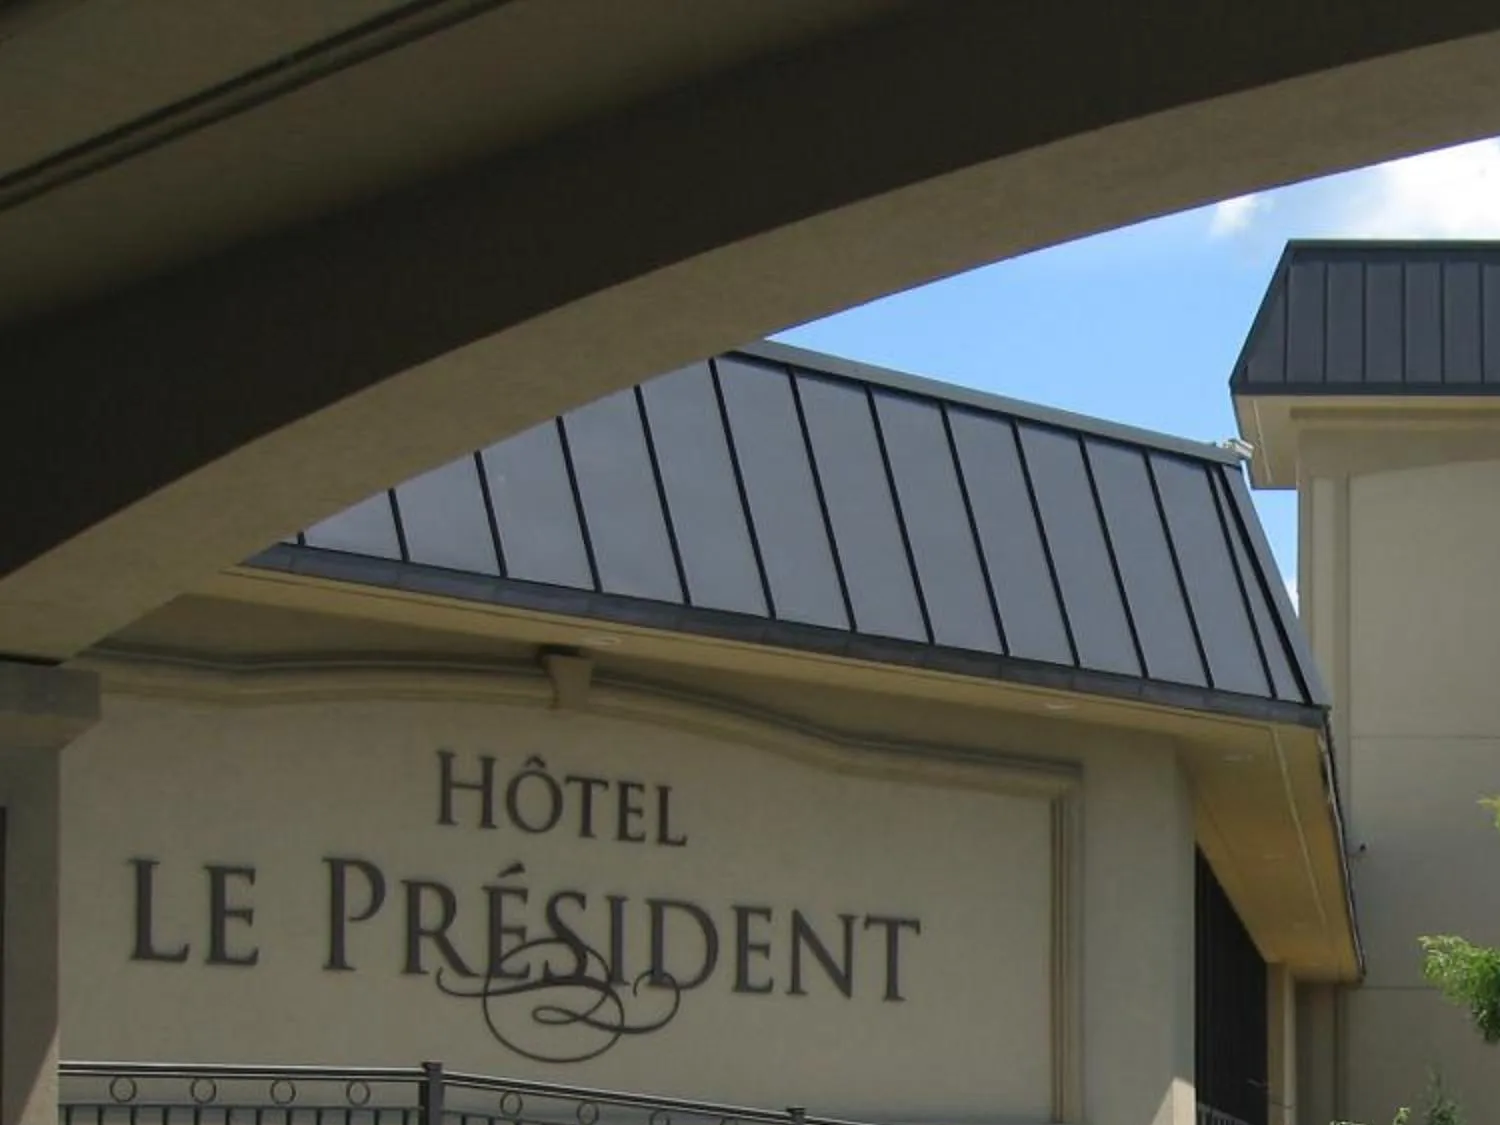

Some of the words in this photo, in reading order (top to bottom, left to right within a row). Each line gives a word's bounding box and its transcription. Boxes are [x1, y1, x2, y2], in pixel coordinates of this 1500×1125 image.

[436, 750, 688, 848] HÔTEL
[128, 857, 261, 968] LE
[321, 856, 922, 1003] PRÉSIDENT
